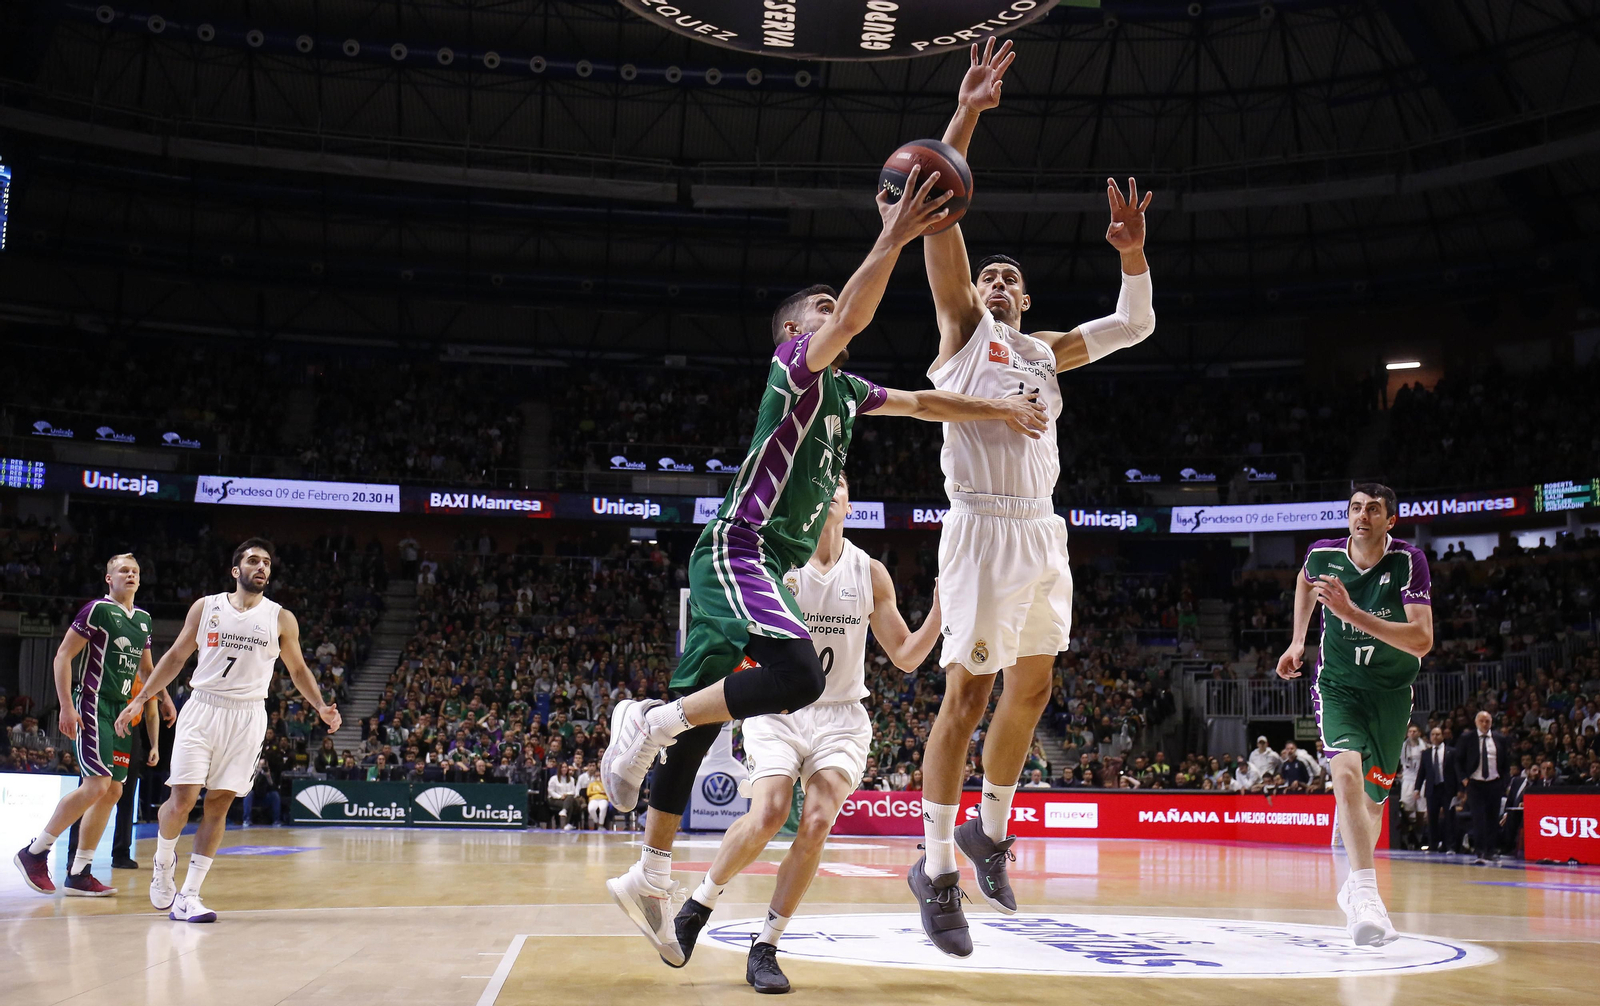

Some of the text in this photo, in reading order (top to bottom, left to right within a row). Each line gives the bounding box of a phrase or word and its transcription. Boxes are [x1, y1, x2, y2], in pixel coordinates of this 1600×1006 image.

[761, 0, 797, 47] SERVA
[860, 1, 899, 50] GRUPO
[911, 0, 1037, 51] PORTICO
[83, 470, 159, 496] Unicaja
[275, 488, 289, 499] 09
[292, 489, 305, 500] de
[308, 490, 349, 502] Febrero
[352, 492, 382, 503] 20.30
[385, 494, 394, 504] H
[430, 493, 542, 512] BAXI Manresa
[593, 498, 661, 517] Unicaja
[870, 511, 878, 520] H
[1400, 497, 1516, 517] BAXI Manresa
[803, 502, 823, 532] 3
[1070, 509, 1138, 528] Unicaja
[1246, 514, 1258, 523] 09
[1261, 513, 1274, 524] de
[1277, 512, 1318, 523] Febrero
[1320, 511, 1349, 521] 20.30
[803, 612, 862, 625] Universidad
[1368, 608, 1392, 618] icaja
[807, 625, 846, 635] uropea
[221, 633, 268, 647] Universidad
[221, 641, 253, 651] Europea
[1355, 645, 1375, 666] 17
[222, 657, 237, 678] 7
[121, 679, 132, 696] 10
[344, 801, 406, 820] Unicaja
[462, 804, 523, 823] Unicaja
[692, 809, 719, 817] Málaga
[965, 807, 1039, 822] SR
[1050, 811, 1094, 819] mueve
[1138, 808, 1329, 826] MAÑANA LA MEJOR COBERTURA EN
[1539, 815, 1600, 839] SUR
